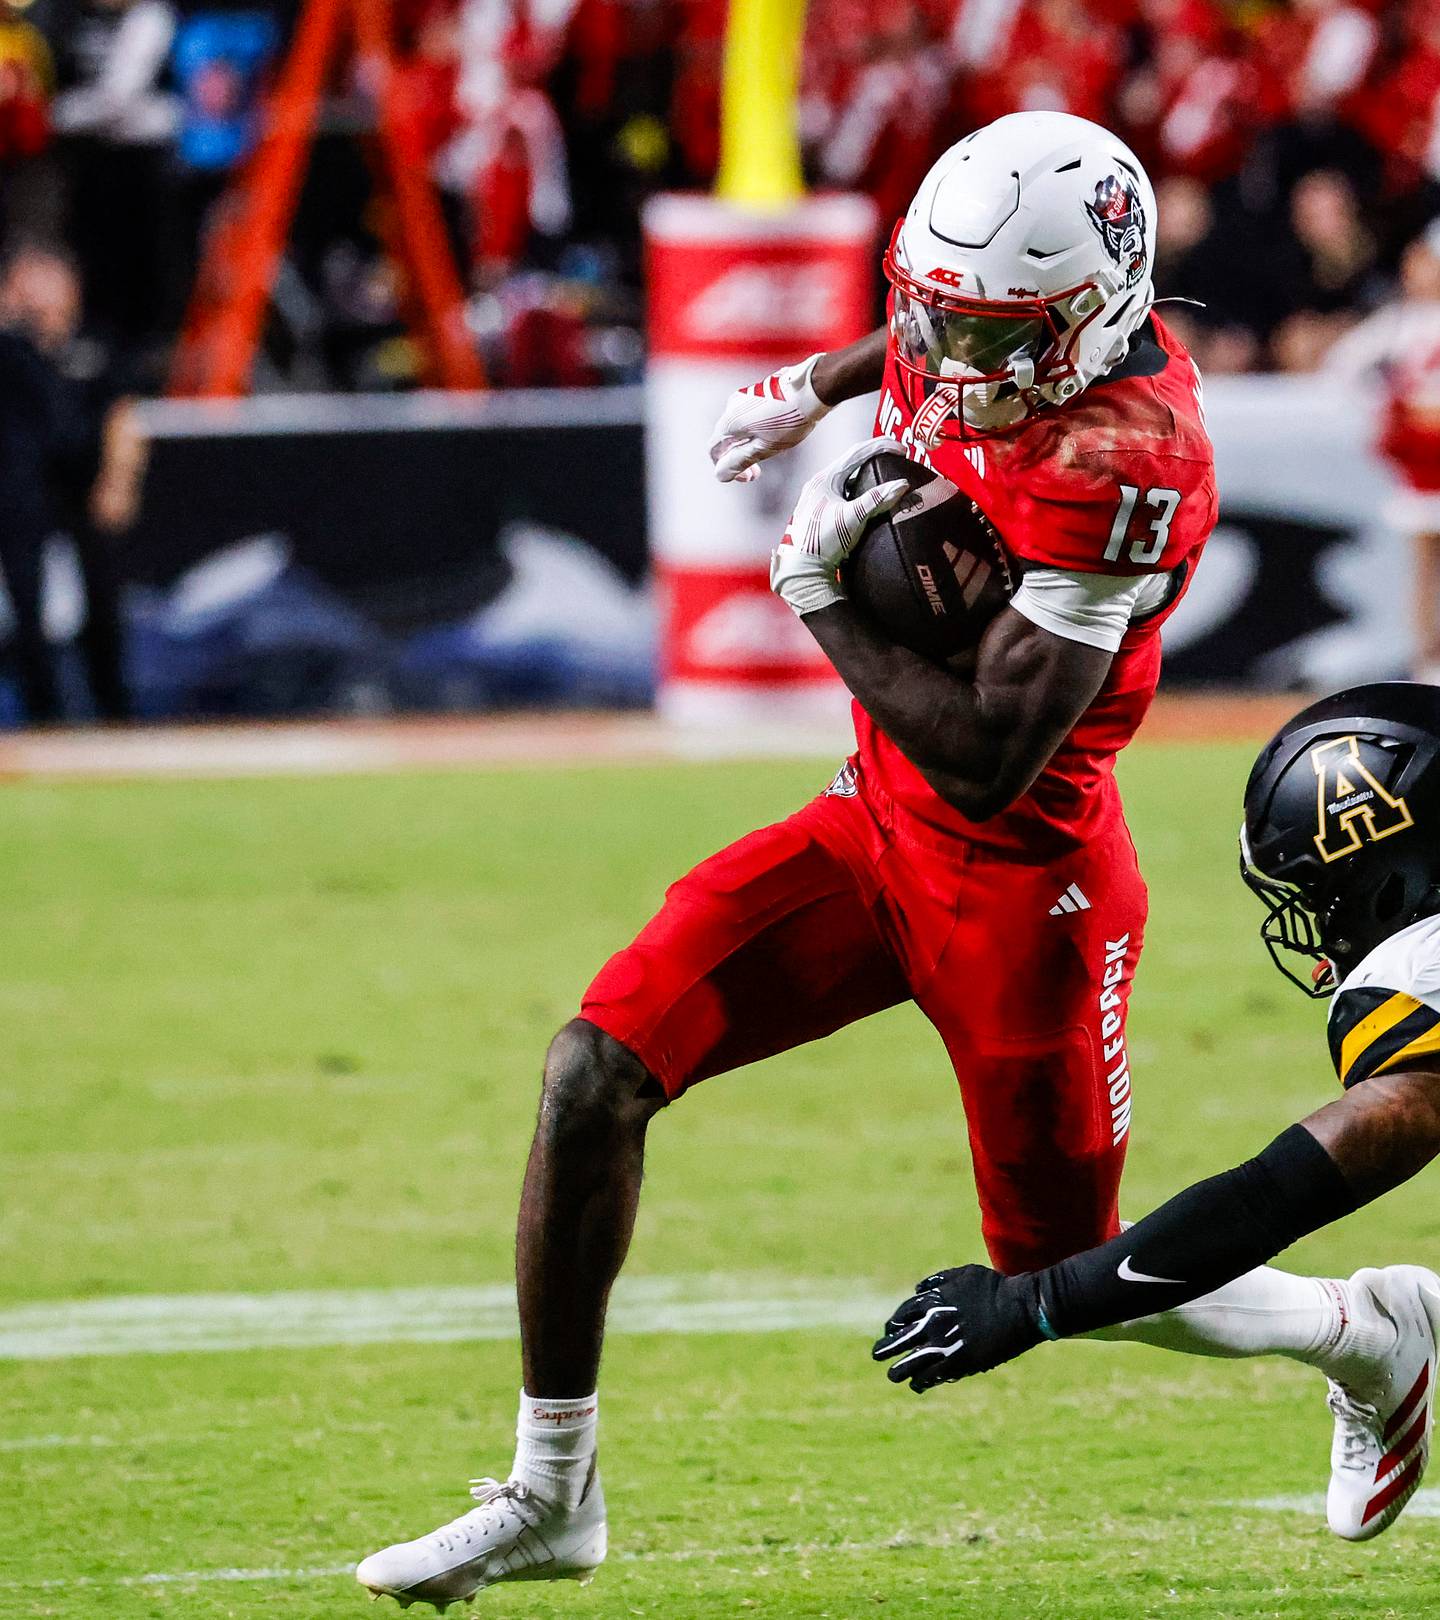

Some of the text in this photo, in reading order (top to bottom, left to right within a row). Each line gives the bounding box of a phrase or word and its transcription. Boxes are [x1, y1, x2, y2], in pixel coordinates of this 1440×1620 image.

[925, 267, 964, 288] ACC
[1103, 484, 1181, 565] 13
[916, 564, 947, 616] DIME
[1311, 735, 1415, 864] A
[1100, 932, 1131, 1147] WOLFPACK
